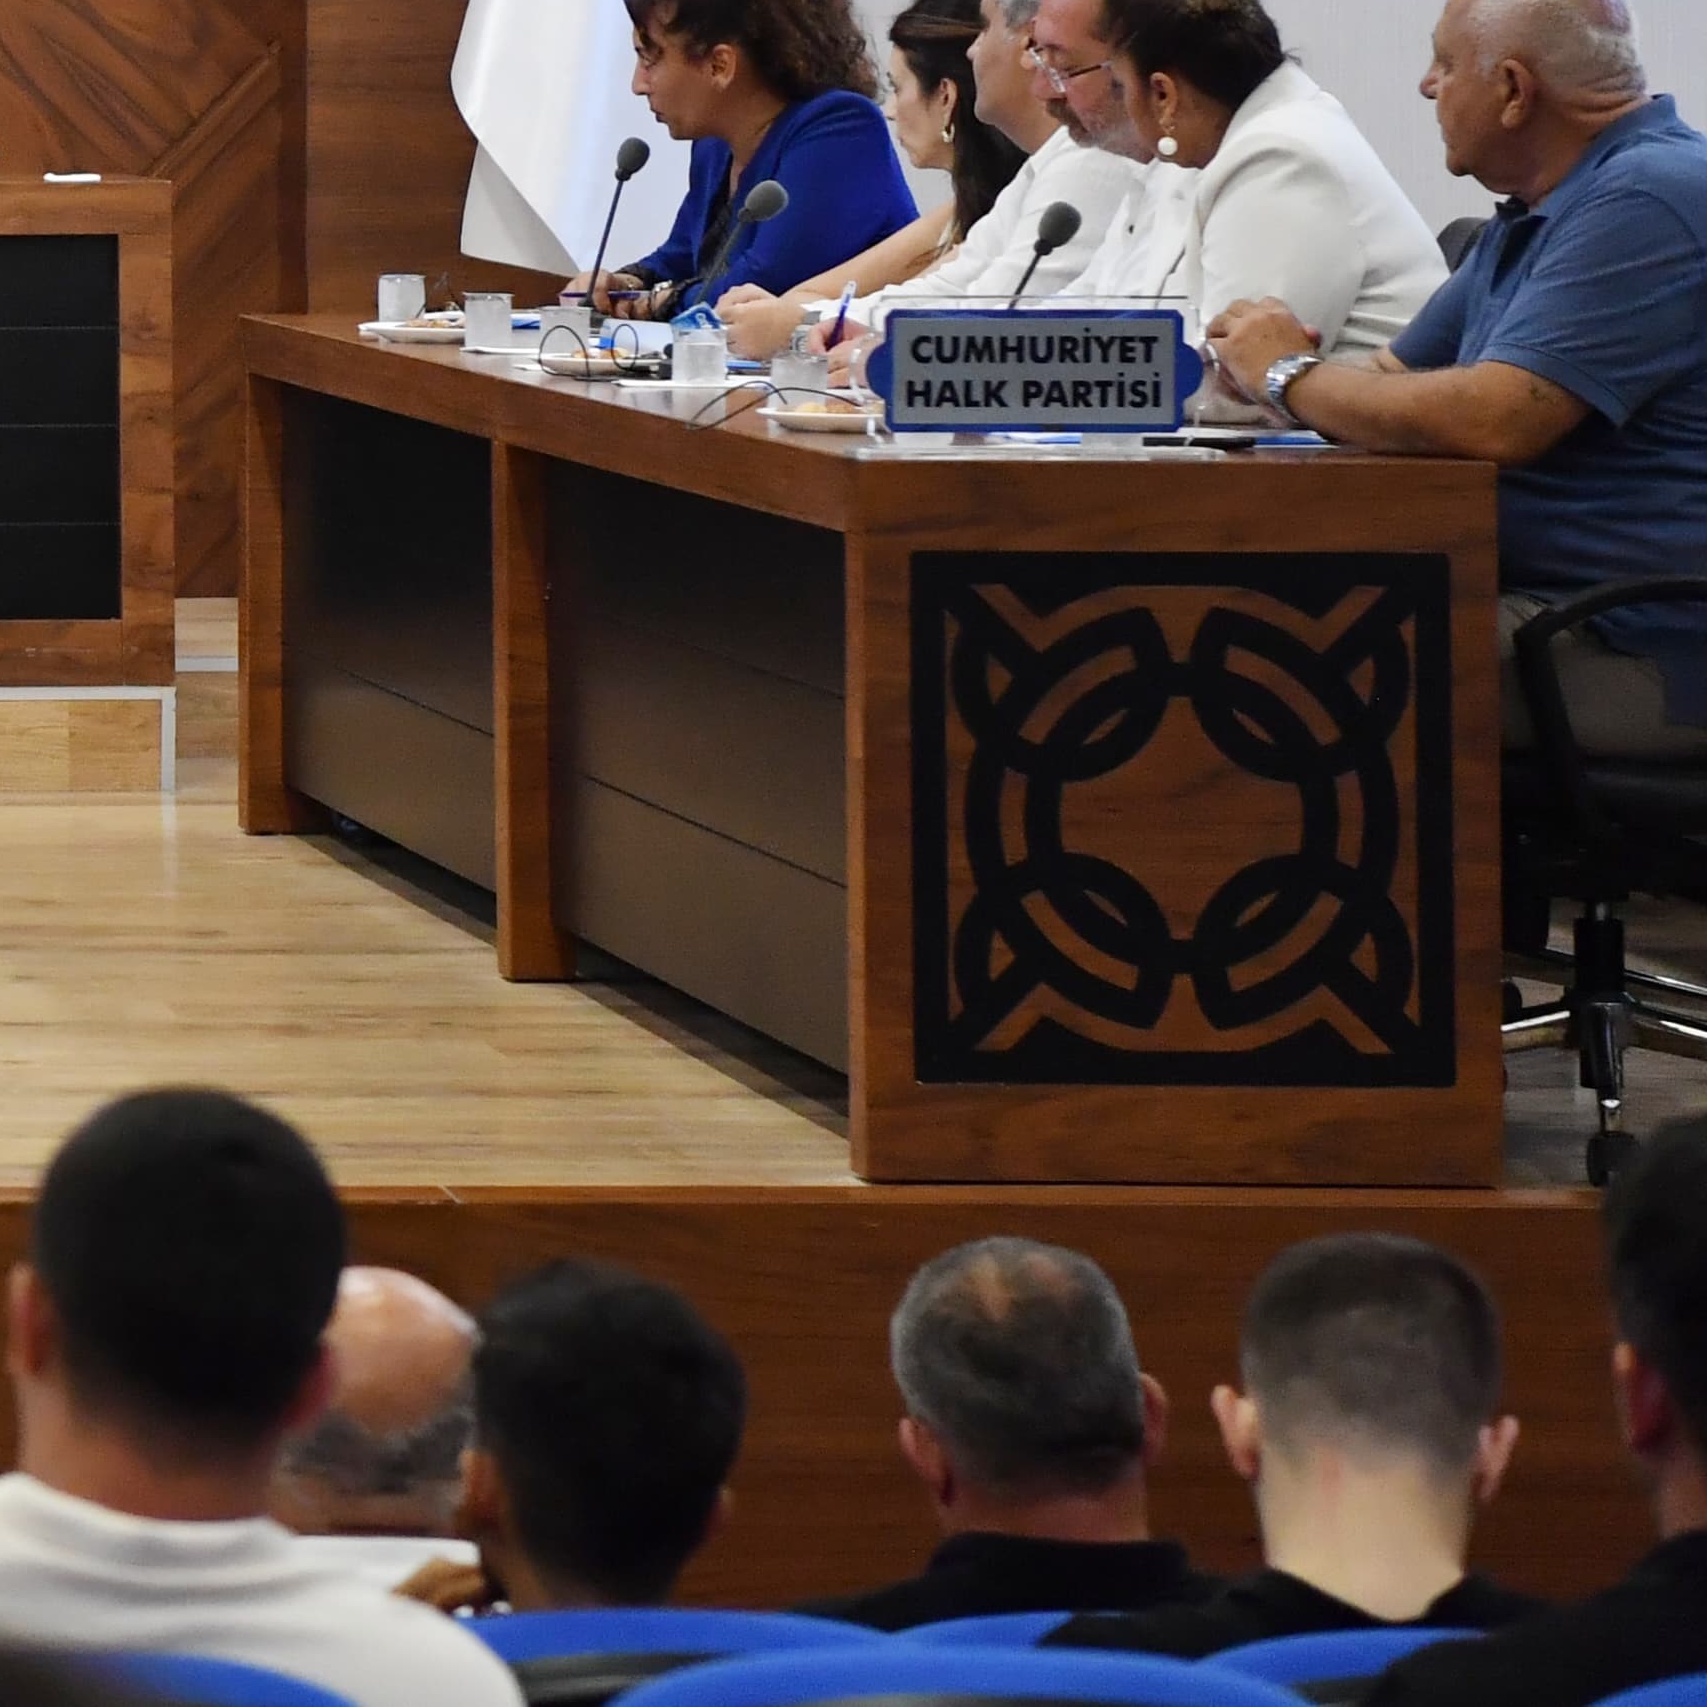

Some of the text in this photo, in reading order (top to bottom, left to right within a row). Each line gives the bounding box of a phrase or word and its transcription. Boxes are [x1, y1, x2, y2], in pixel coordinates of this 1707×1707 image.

[910, 327, 1159, 365] CUMHURİYET
[906, 371, 1162, 409] HALK PARTİSİ
